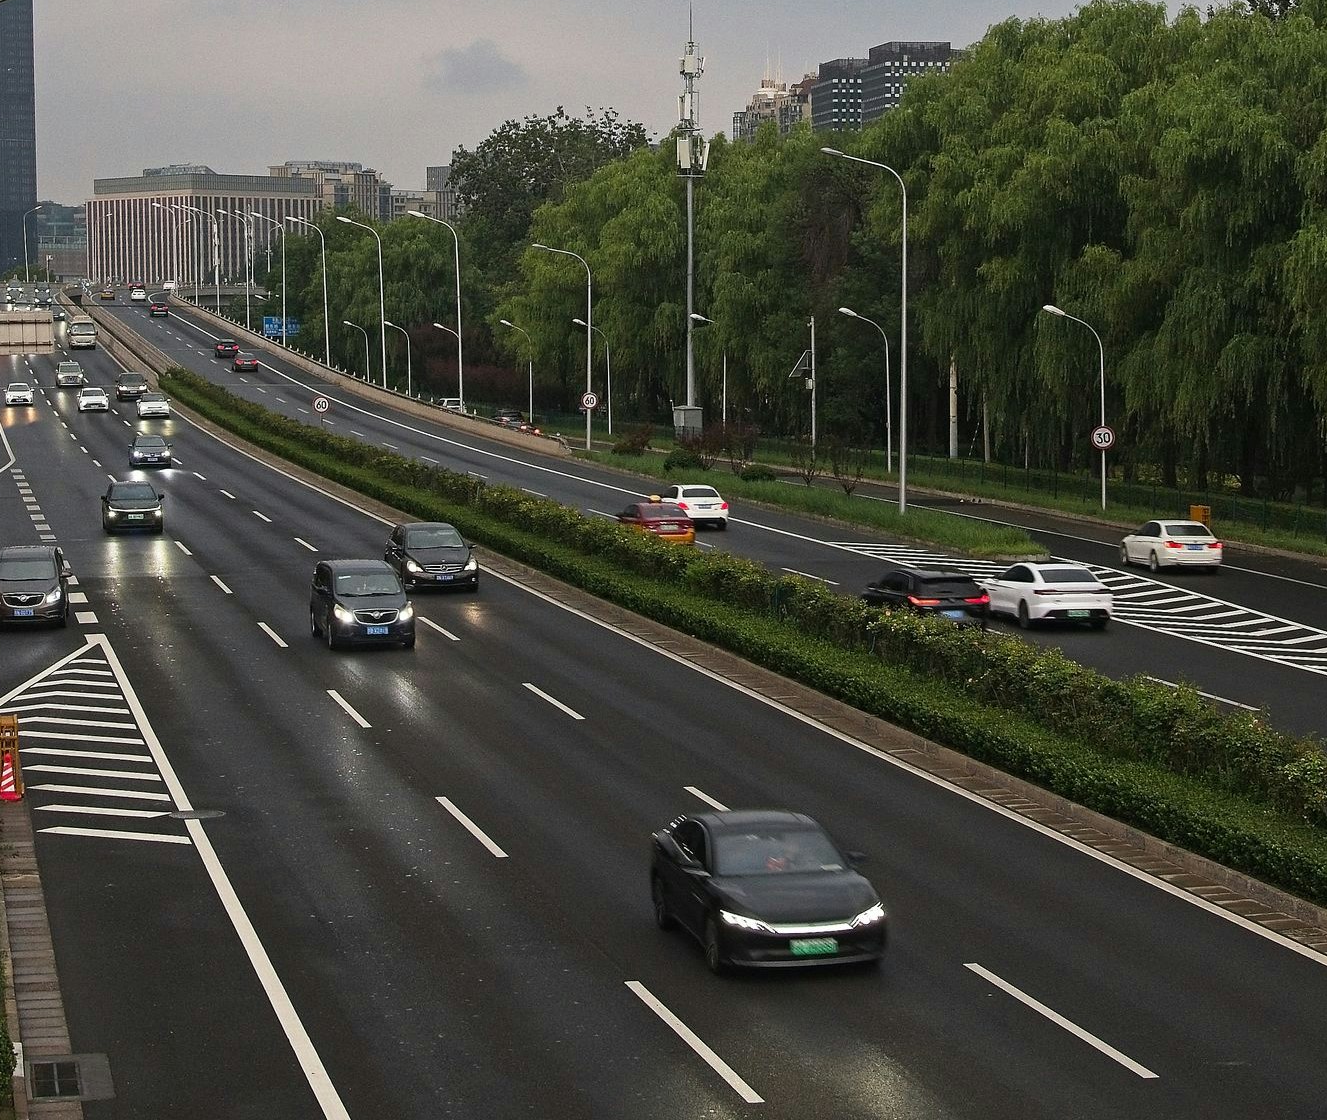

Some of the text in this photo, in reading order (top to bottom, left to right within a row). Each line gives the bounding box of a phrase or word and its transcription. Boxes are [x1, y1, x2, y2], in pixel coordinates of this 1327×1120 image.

[317, 400, 327, 409] 60
[585, 396, 594, 404] 60
[1096, 432, 1110, 443] 30
